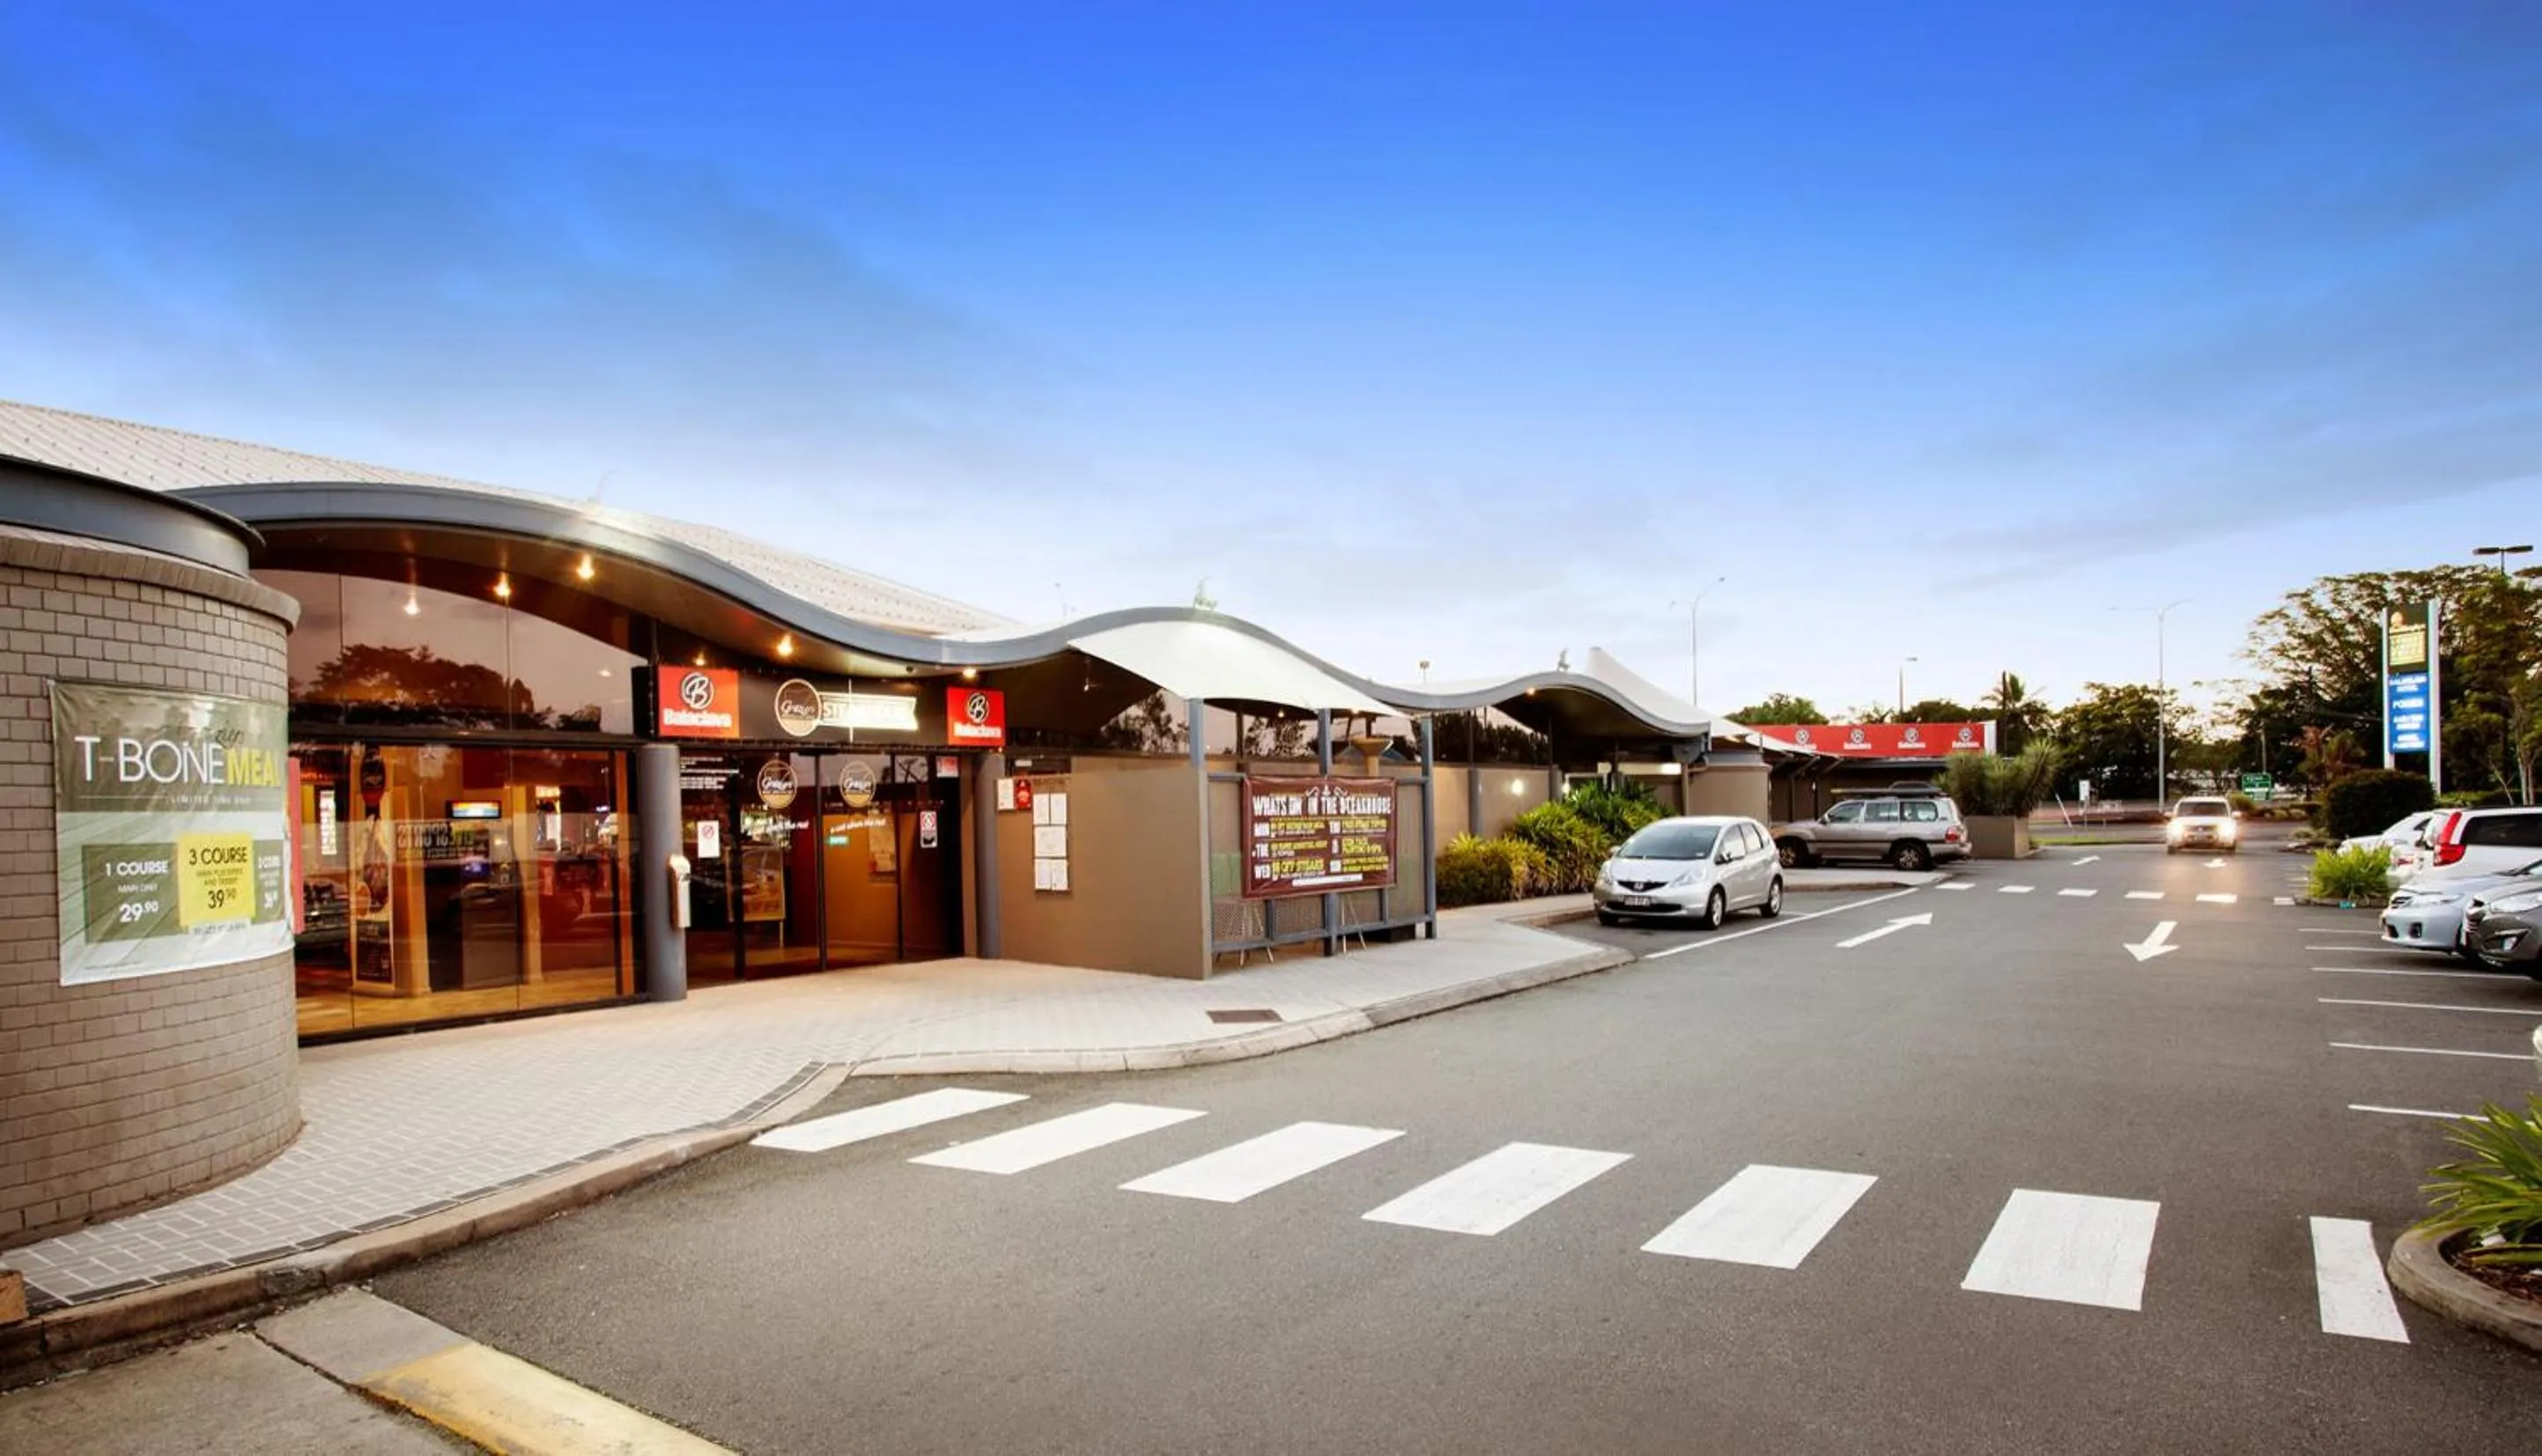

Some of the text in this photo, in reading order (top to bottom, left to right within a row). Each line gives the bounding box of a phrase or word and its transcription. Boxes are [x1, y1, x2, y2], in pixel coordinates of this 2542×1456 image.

[74, 735, 225, 784] T-BONE
[188, 846, 248, 865] 3 COURSE
[106, 860, 168, 877] 1 COURSE
